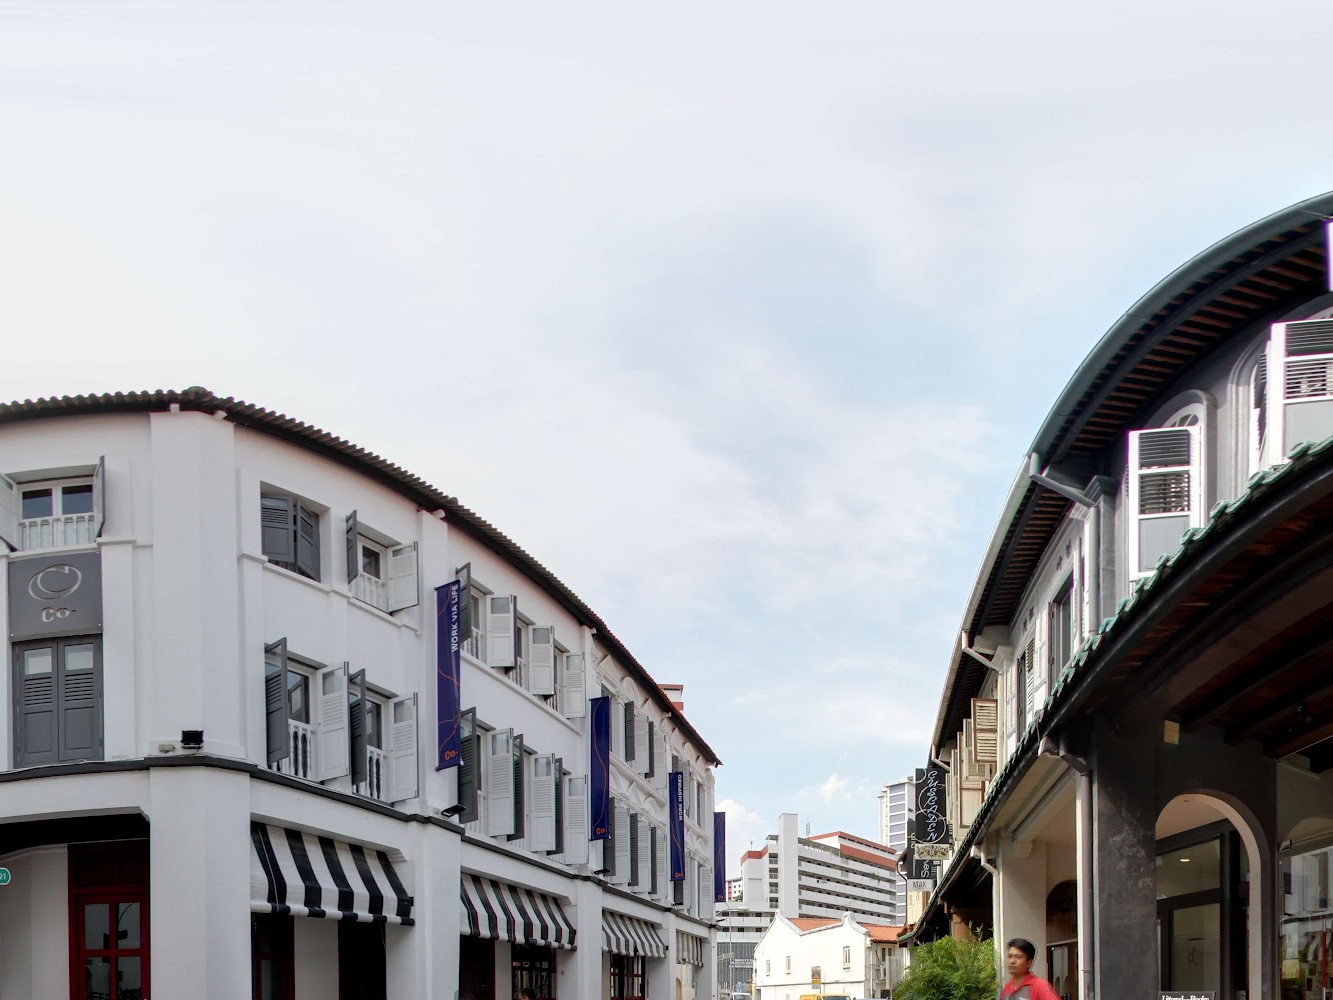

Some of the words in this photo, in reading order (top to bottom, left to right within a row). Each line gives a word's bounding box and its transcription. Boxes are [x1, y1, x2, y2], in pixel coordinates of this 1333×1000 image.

[451, 585, 459, 604] LIFE
[451, 623, 459, 653] WORK
[913, 881, 927, 889] Max
